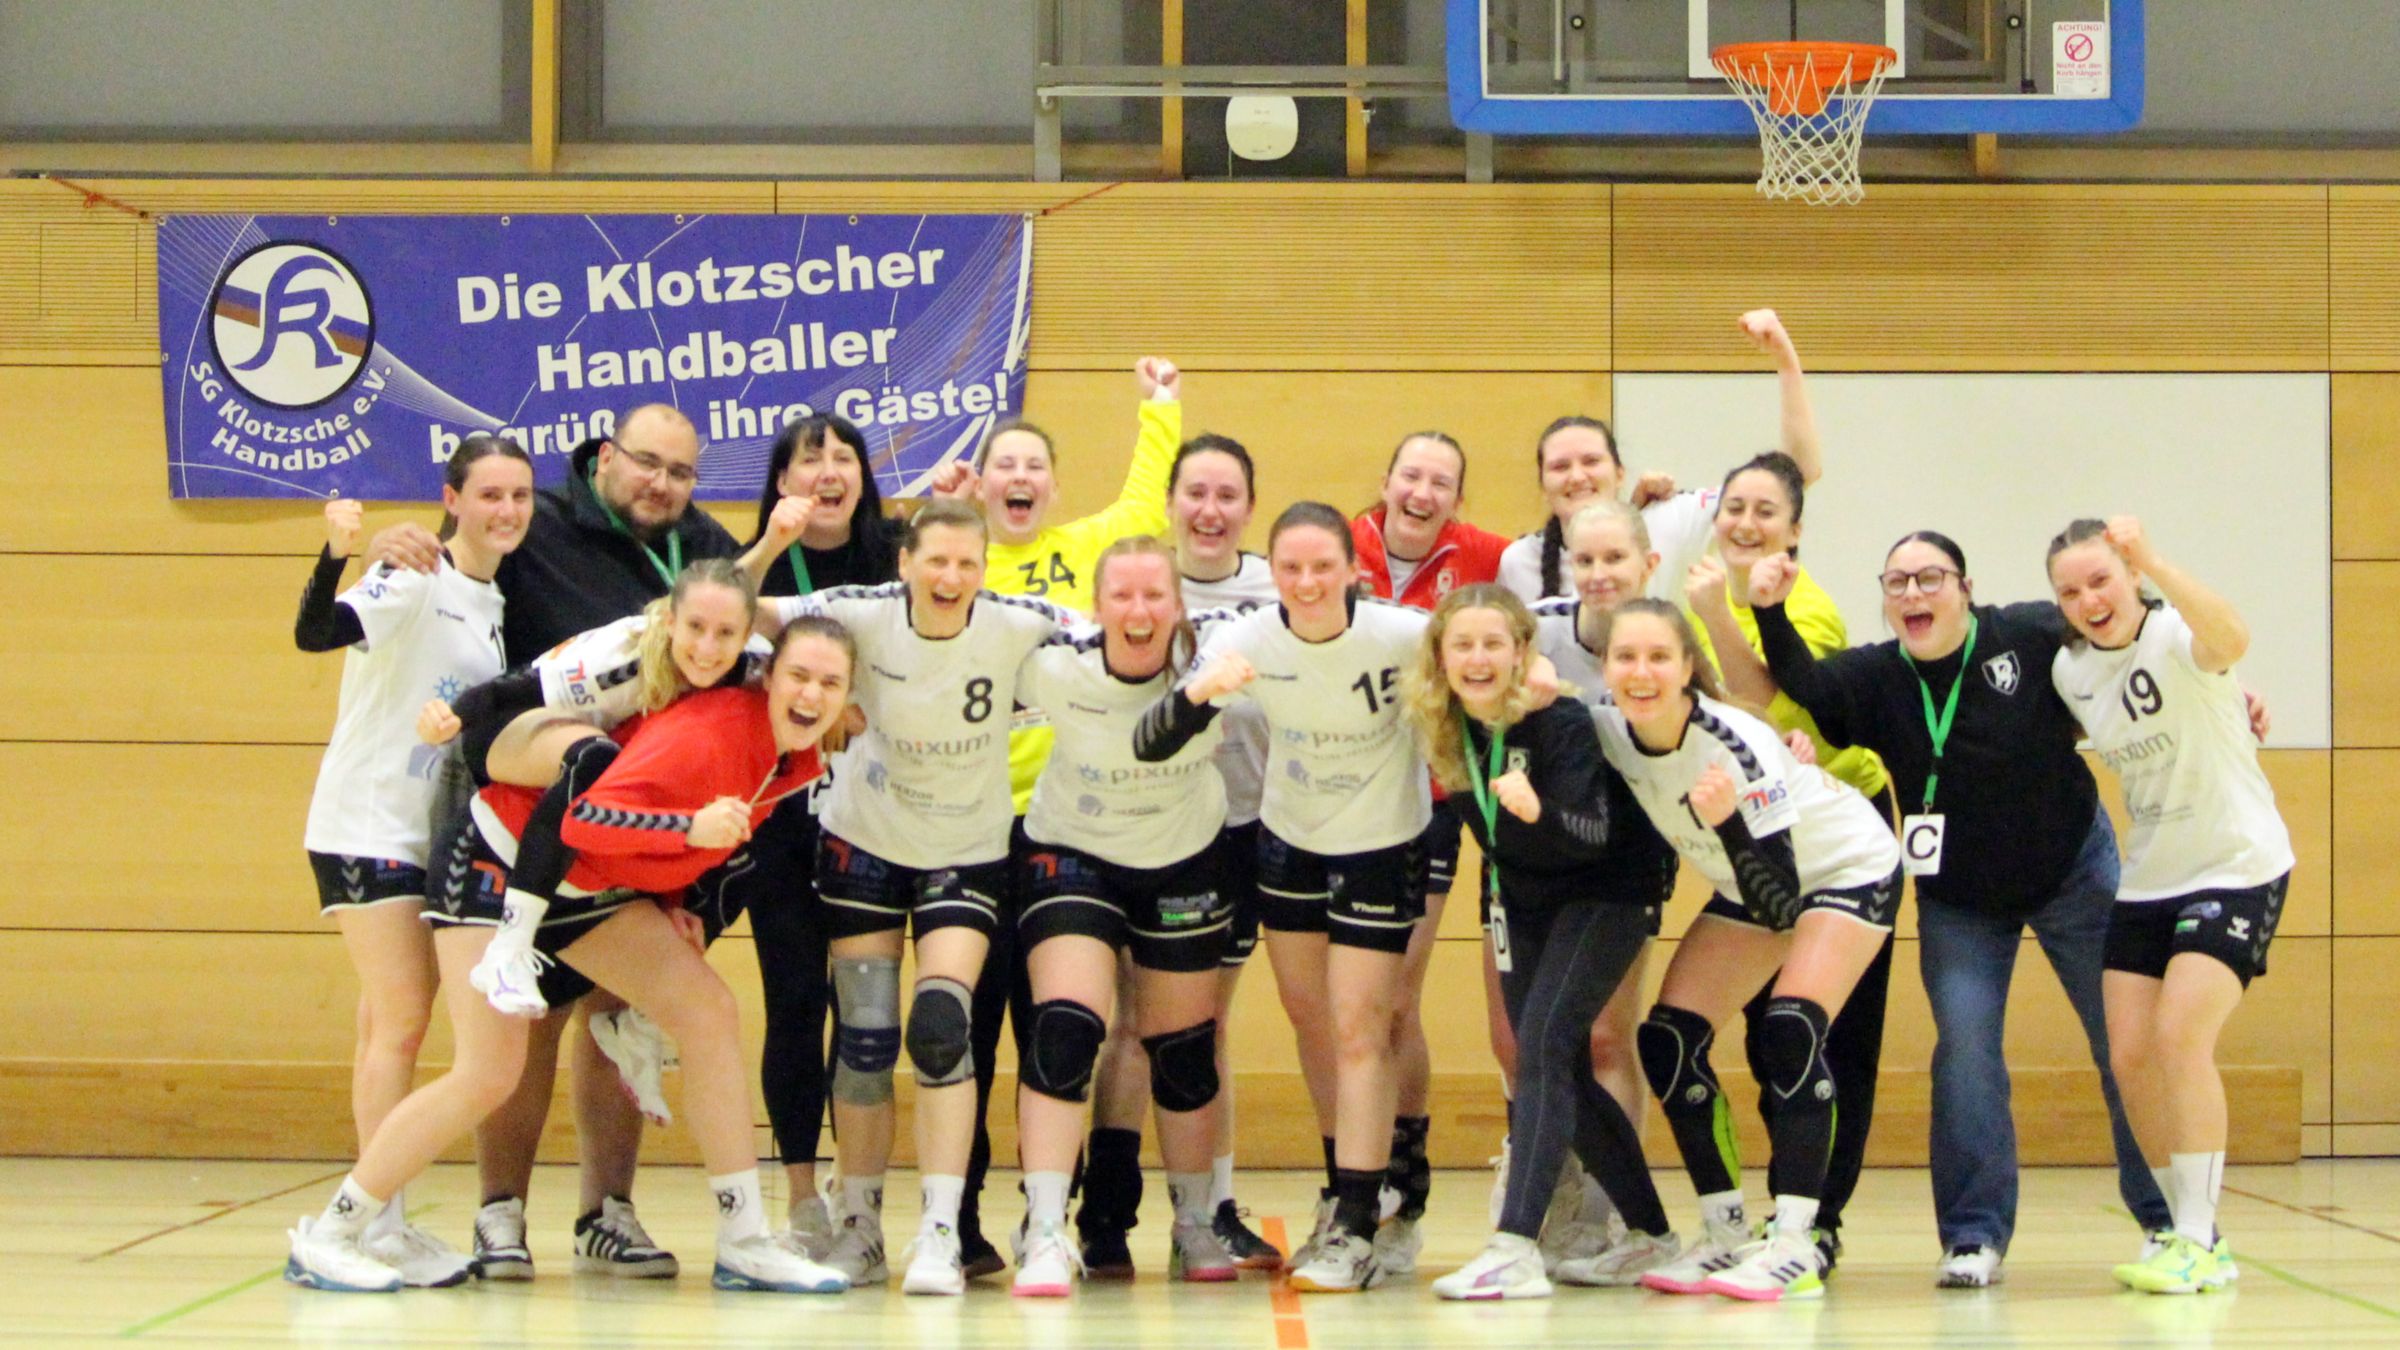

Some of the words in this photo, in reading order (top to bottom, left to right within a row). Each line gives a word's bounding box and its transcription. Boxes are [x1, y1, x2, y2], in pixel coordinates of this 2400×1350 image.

[2057, 23, 2102, 31] ACHTUNG!
[457, 273, 562, 323] Die
[587, 245, 944, 313] Klotzscher
[537, 322, 897, 392] Handballer
[190, 360, 223, 402] SG
[217, 398, 352, 444] Klotzsche
[353, 366, 392, 415] e.V.
[834, 372, 1008, 429] Gäste!
[211, 427, 372, 471] Handball
[1018, 551, 1076, 596] 34
[963, 677, 993, 724] 8
[1352, 666, 1400, 714] 15
[2122, 667, 2163, 722] 19
[1906, 824, 1938, 860] C
